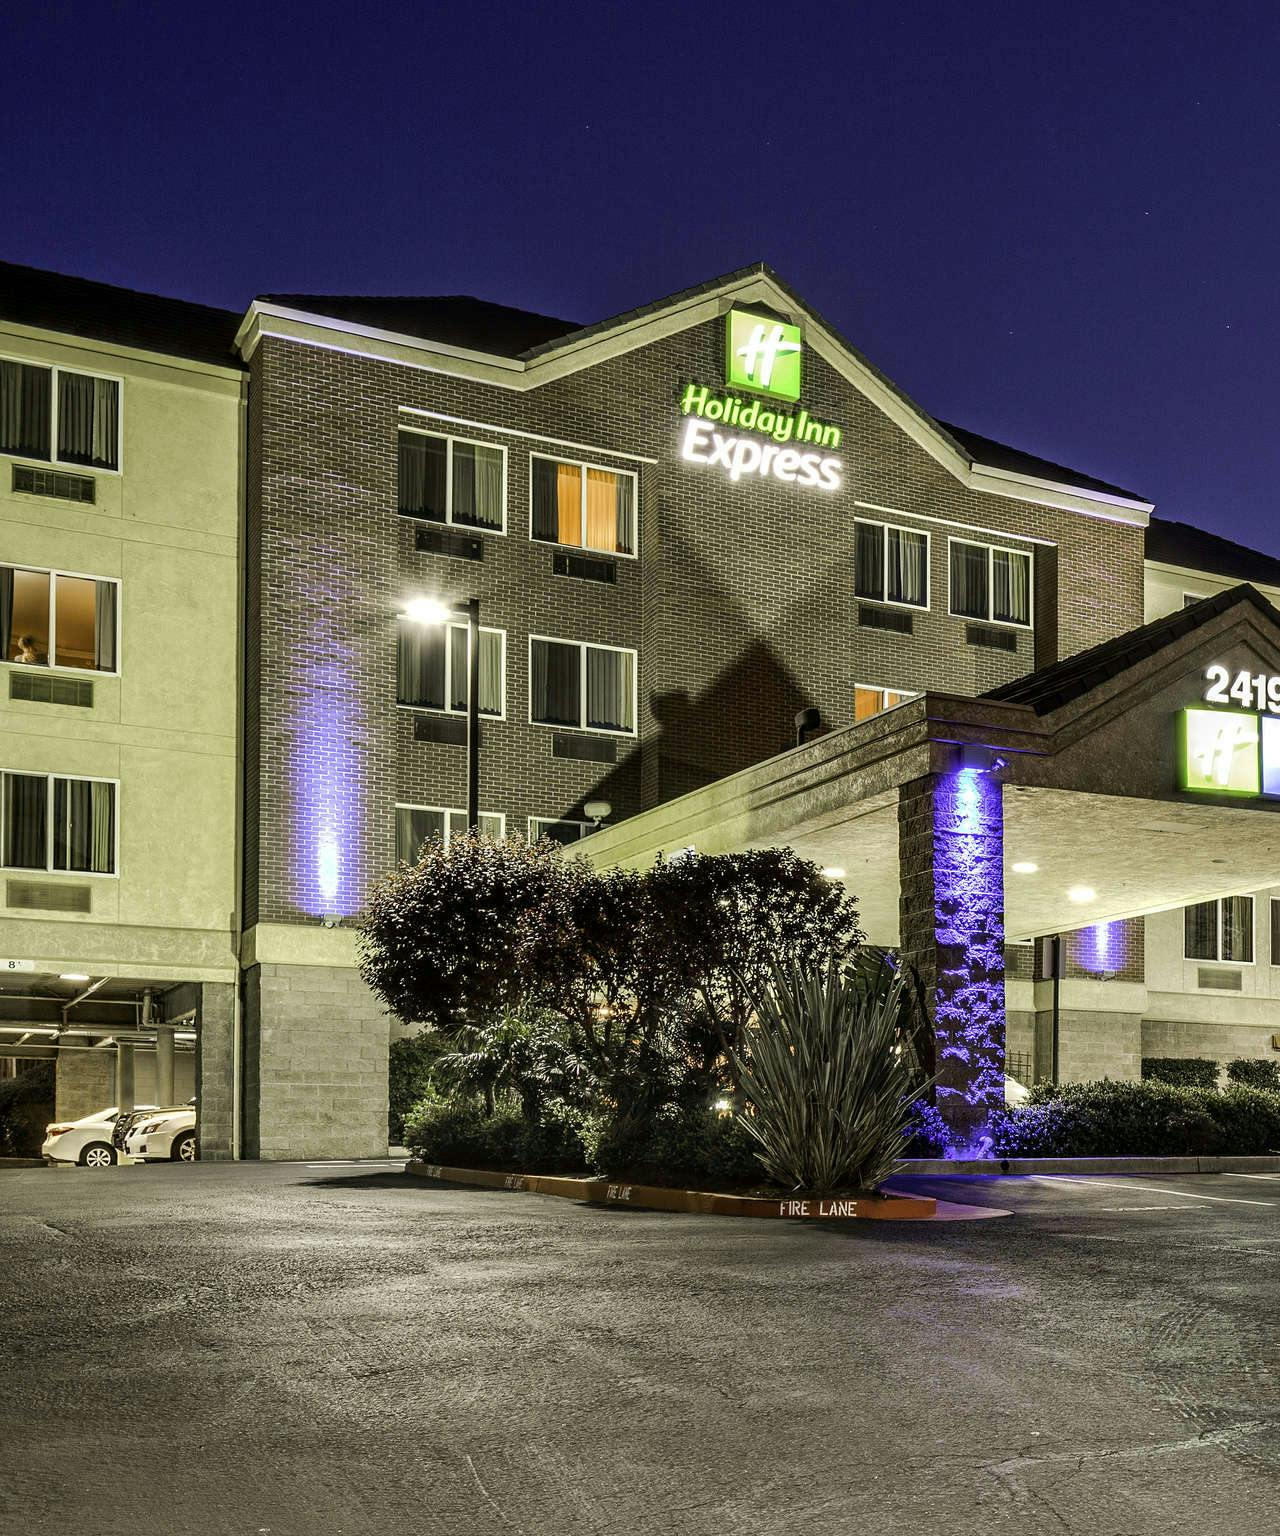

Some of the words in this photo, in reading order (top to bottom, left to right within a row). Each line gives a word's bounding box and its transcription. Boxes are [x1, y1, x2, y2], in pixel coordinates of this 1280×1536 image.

[681, 384, 794, 442] Holiday
[797, 411, 842, 449] Inn
[682, 418, 843, 491] Express
[779, 1200, 811, 1216] FIRE
[819, 1200, 858, 1217] LANE
